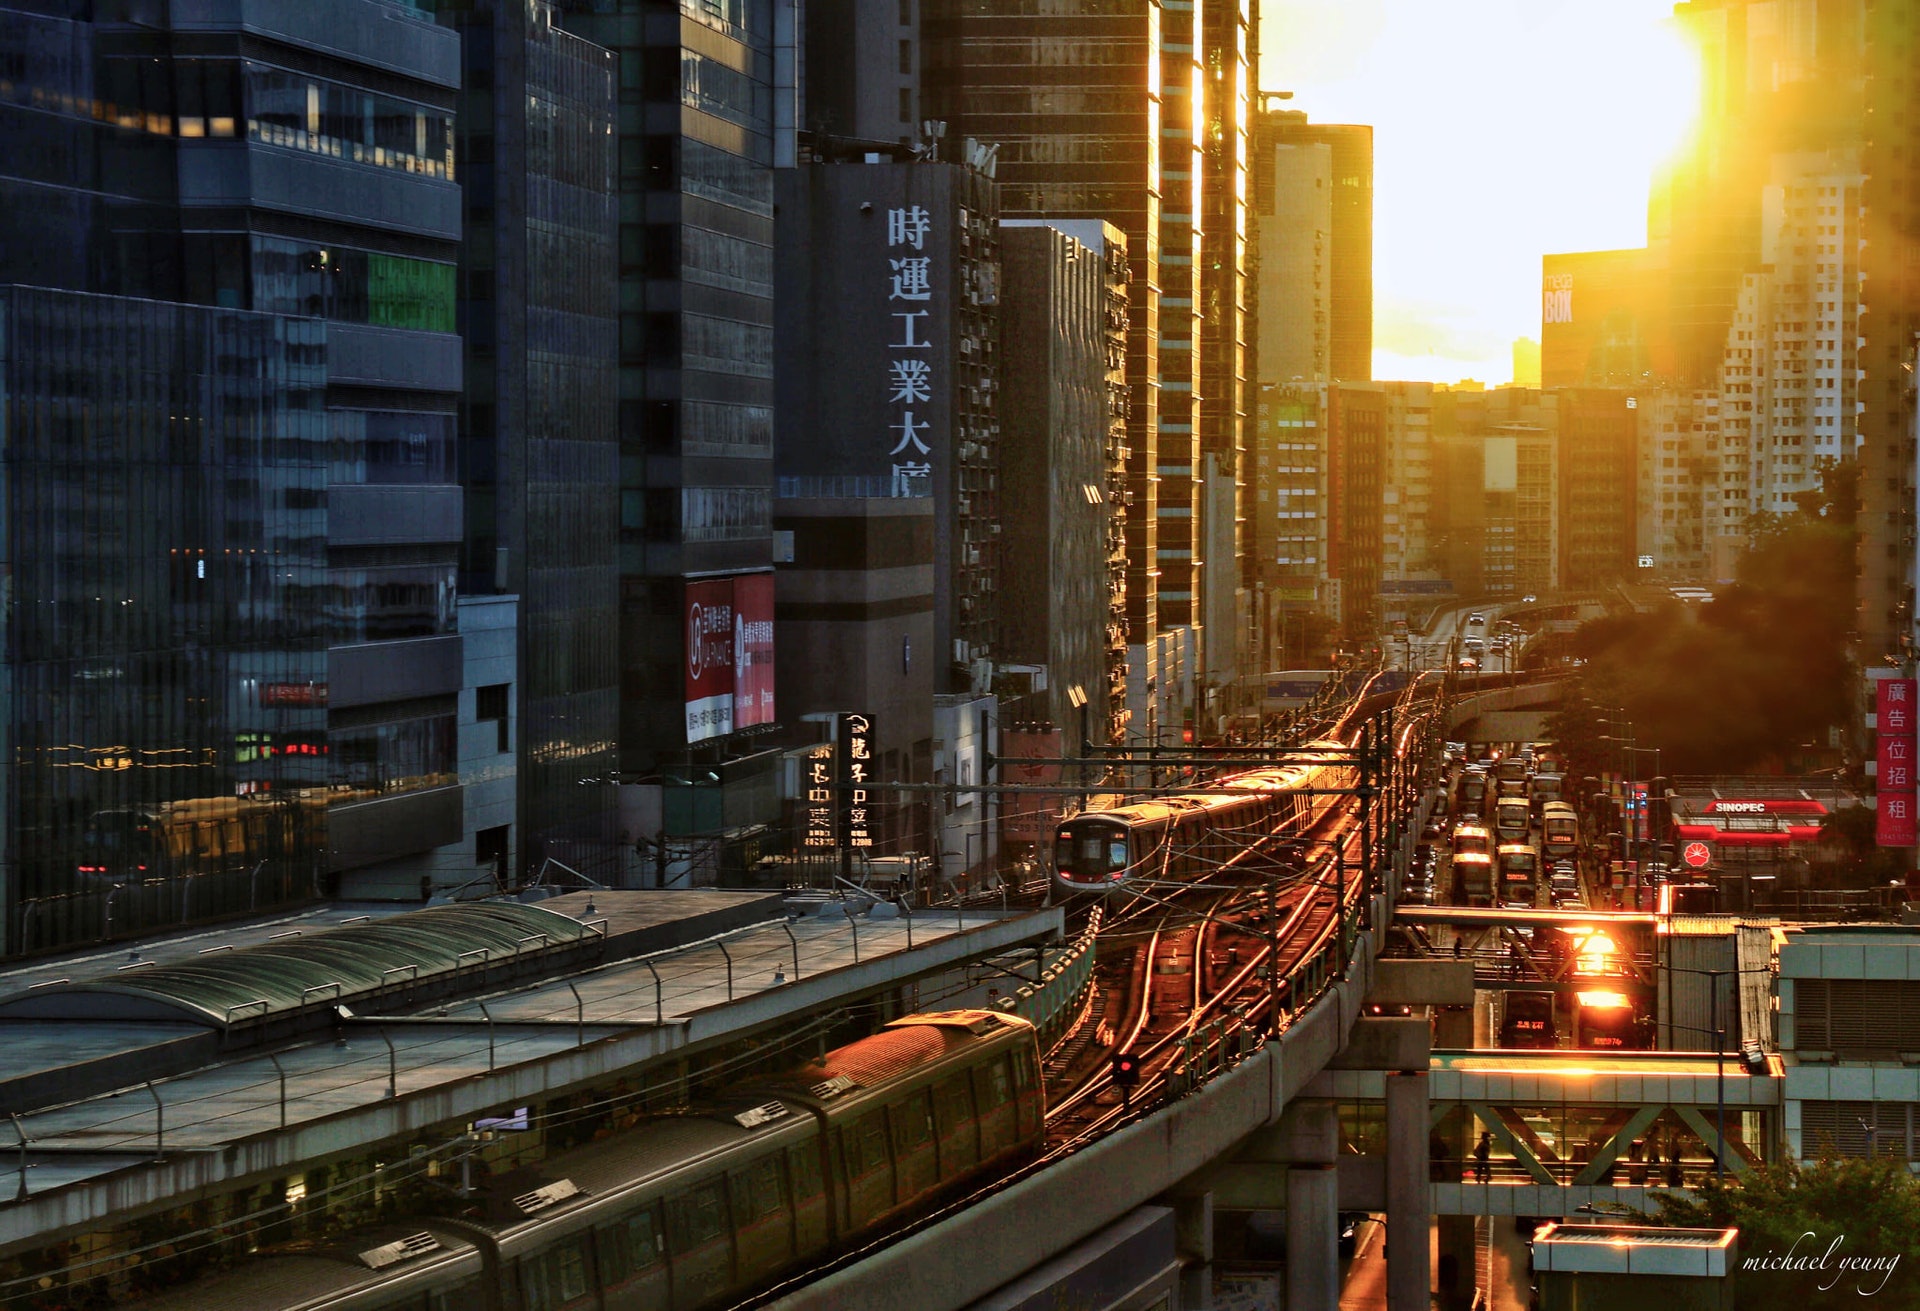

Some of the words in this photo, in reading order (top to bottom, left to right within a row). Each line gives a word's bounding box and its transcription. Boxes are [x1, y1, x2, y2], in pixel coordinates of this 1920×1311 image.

[1545, 290, 1572, 323] BOX
[1887, 683, 1907, 819] 廣告位招租
[1715, 803, 1765, 812] SINOPEC
